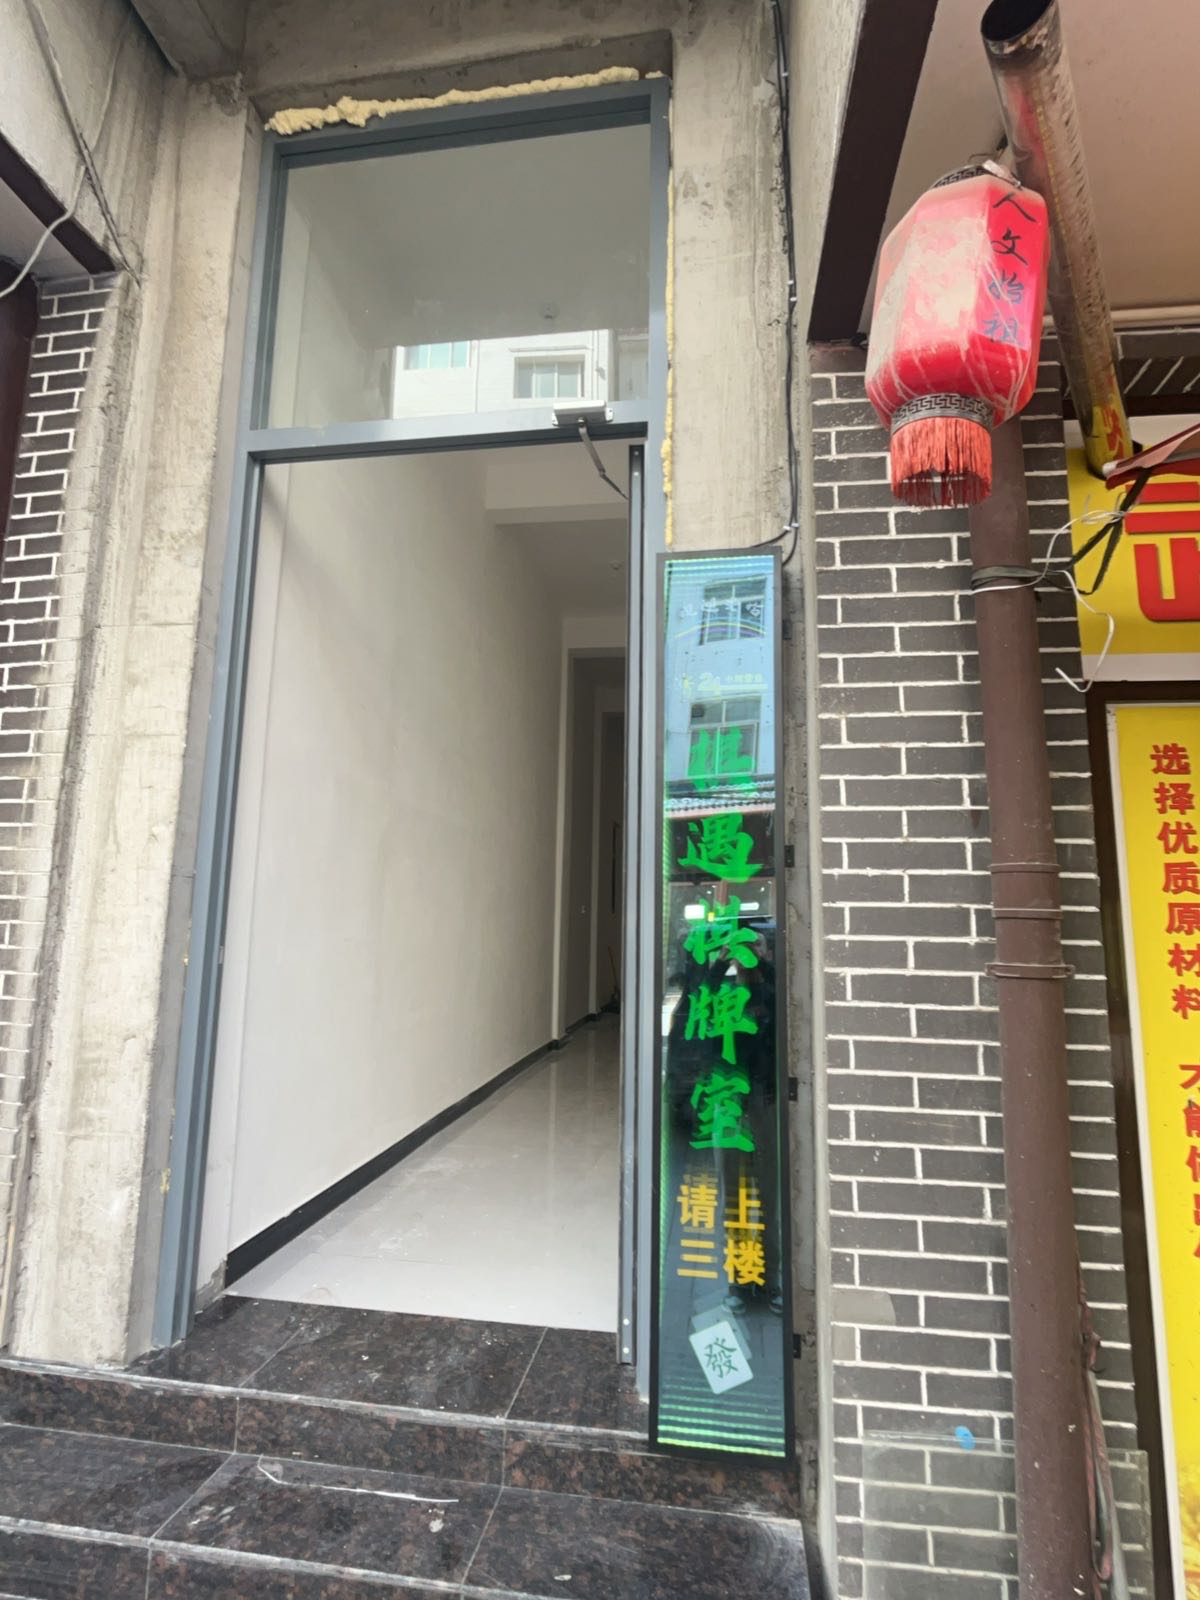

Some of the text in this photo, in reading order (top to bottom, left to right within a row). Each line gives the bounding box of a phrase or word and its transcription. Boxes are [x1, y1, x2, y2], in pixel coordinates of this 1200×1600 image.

[983, 192, 1037, 344] 人文始祖
[1150, 742, 1200, 1020] 选择优质原材料
[677, 1184, 765, 1231] 请上
[677, 1239, 766, 1286] 三楼
[704, 1337, 738, 1379] 發
